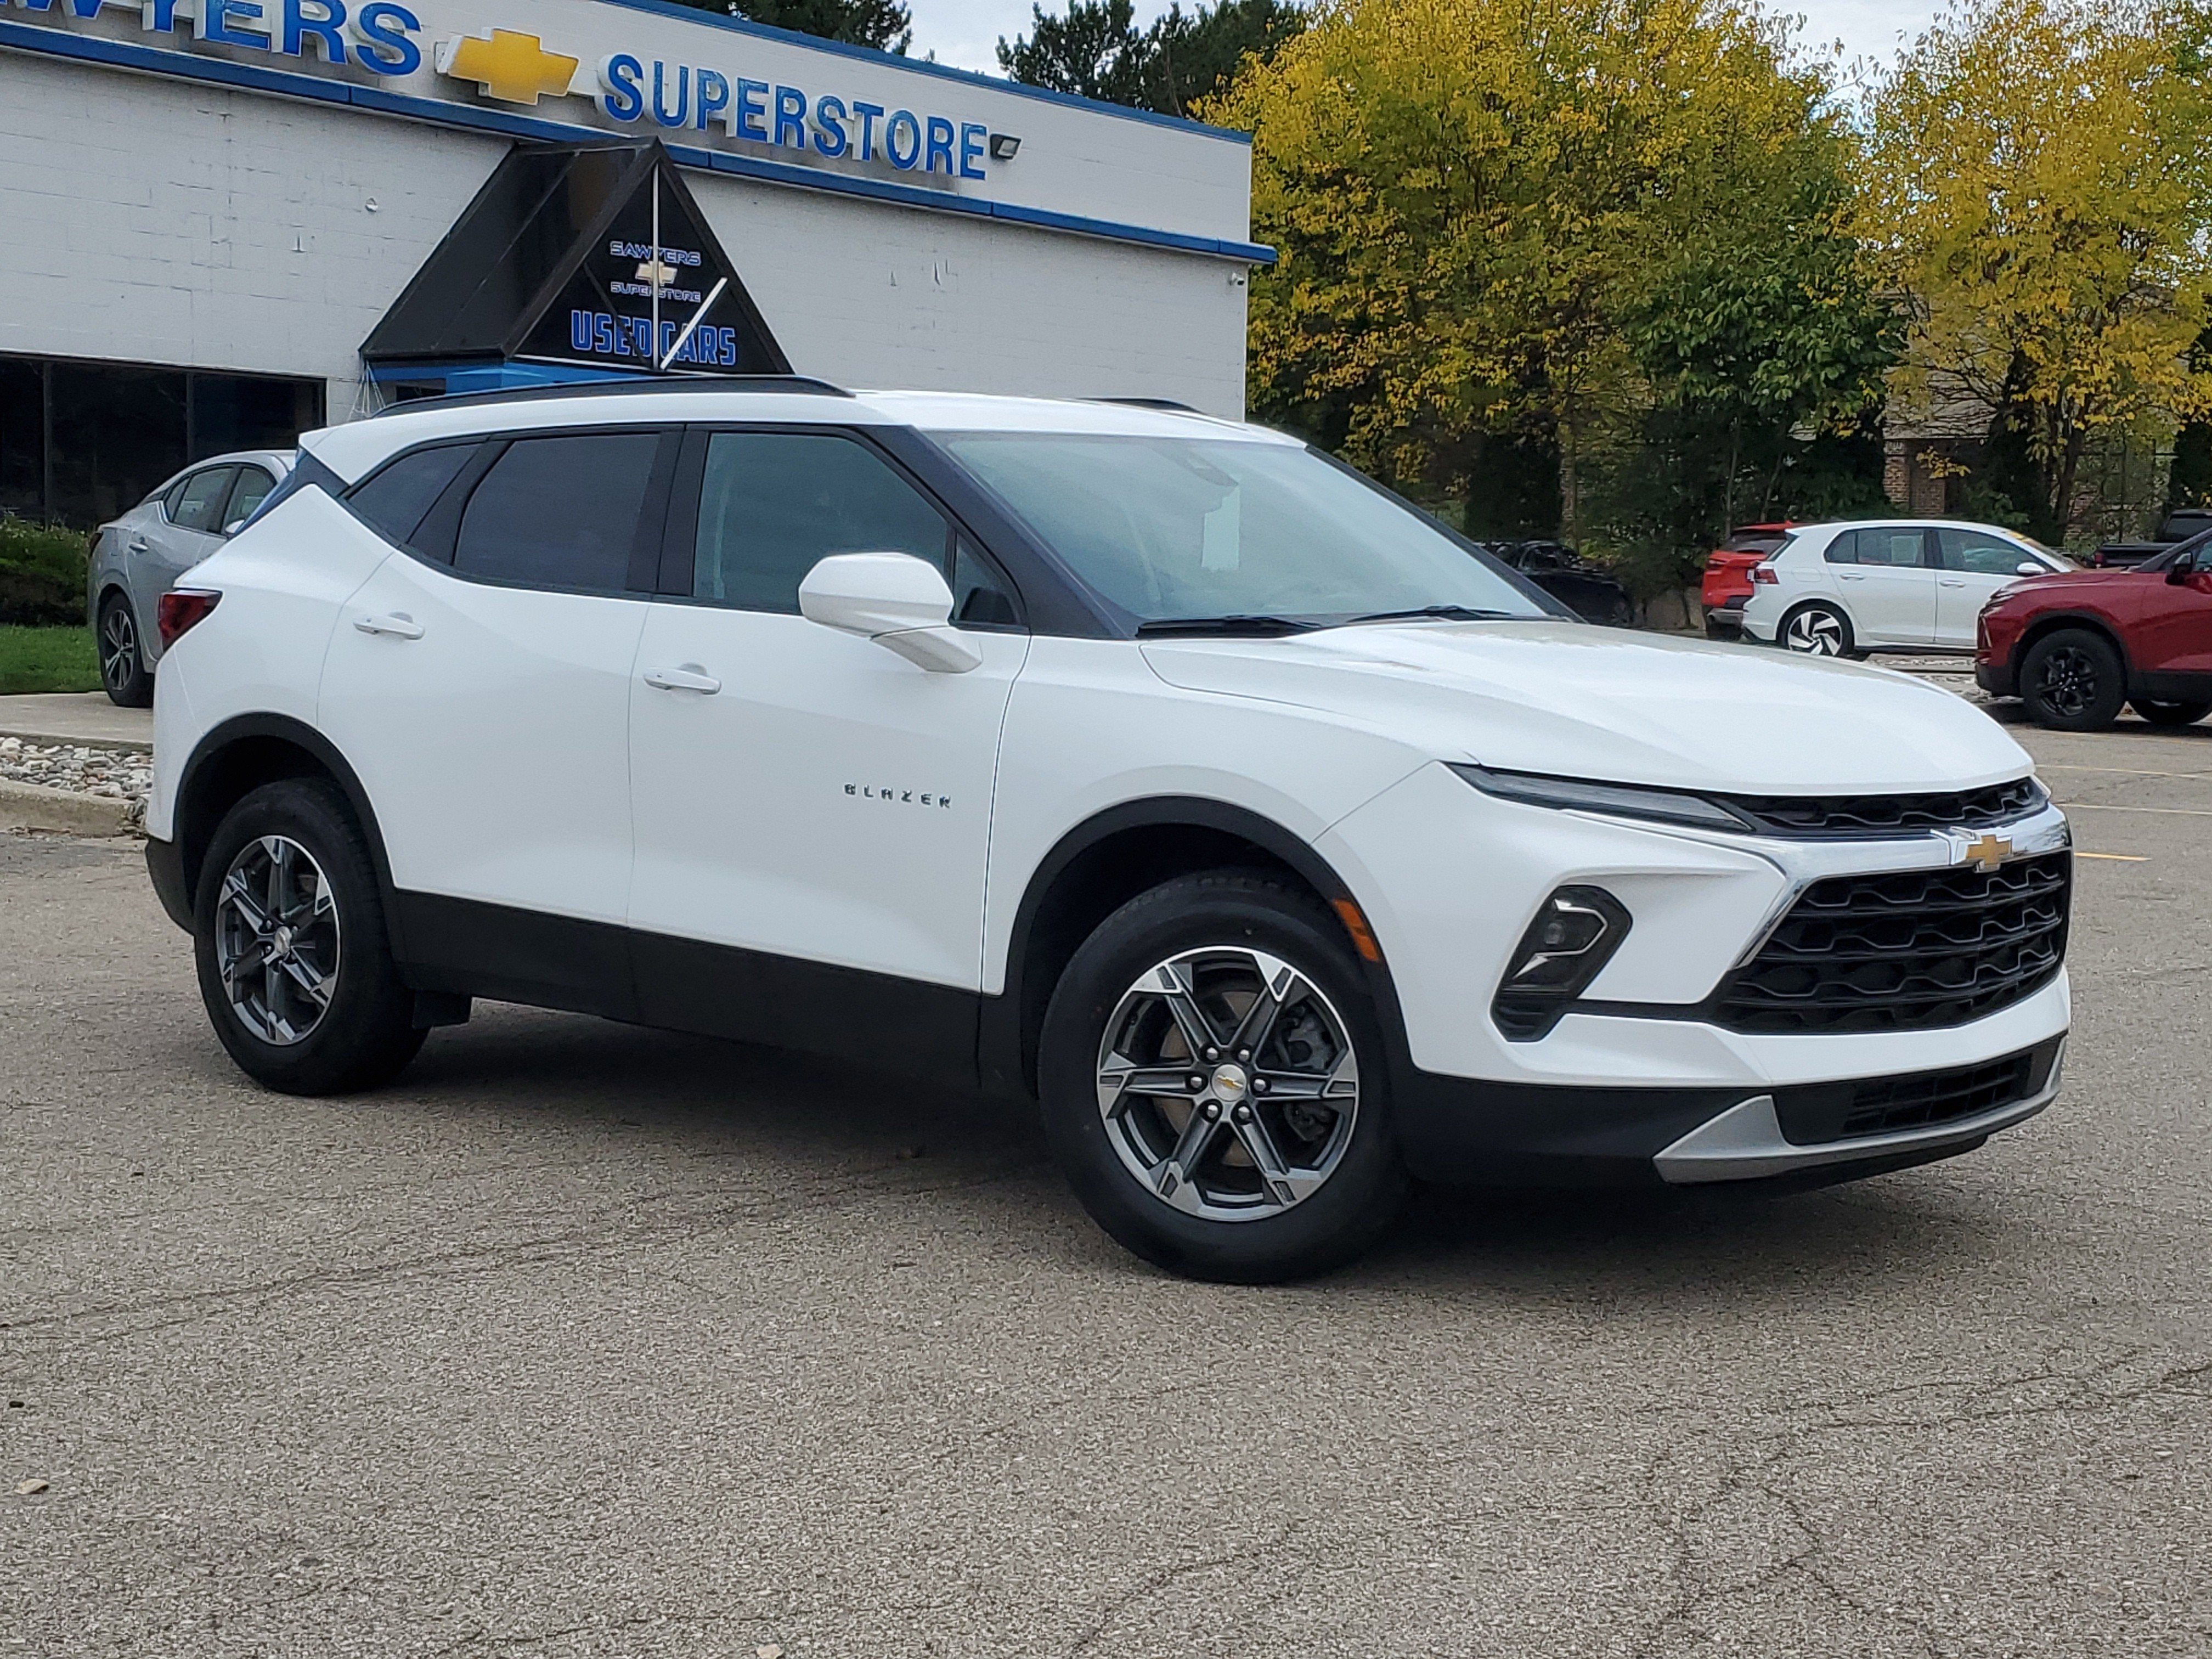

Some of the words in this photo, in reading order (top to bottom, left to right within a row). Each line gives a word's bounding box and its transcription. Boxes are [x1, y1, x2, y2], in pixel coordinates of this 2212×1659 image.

[603, 53, 987, 180] SUPERSTORE
[571, 309, 652, 358] USED
[659, 320, 736, 365] CARS
[844, 783, 951, 809] BLAZER
